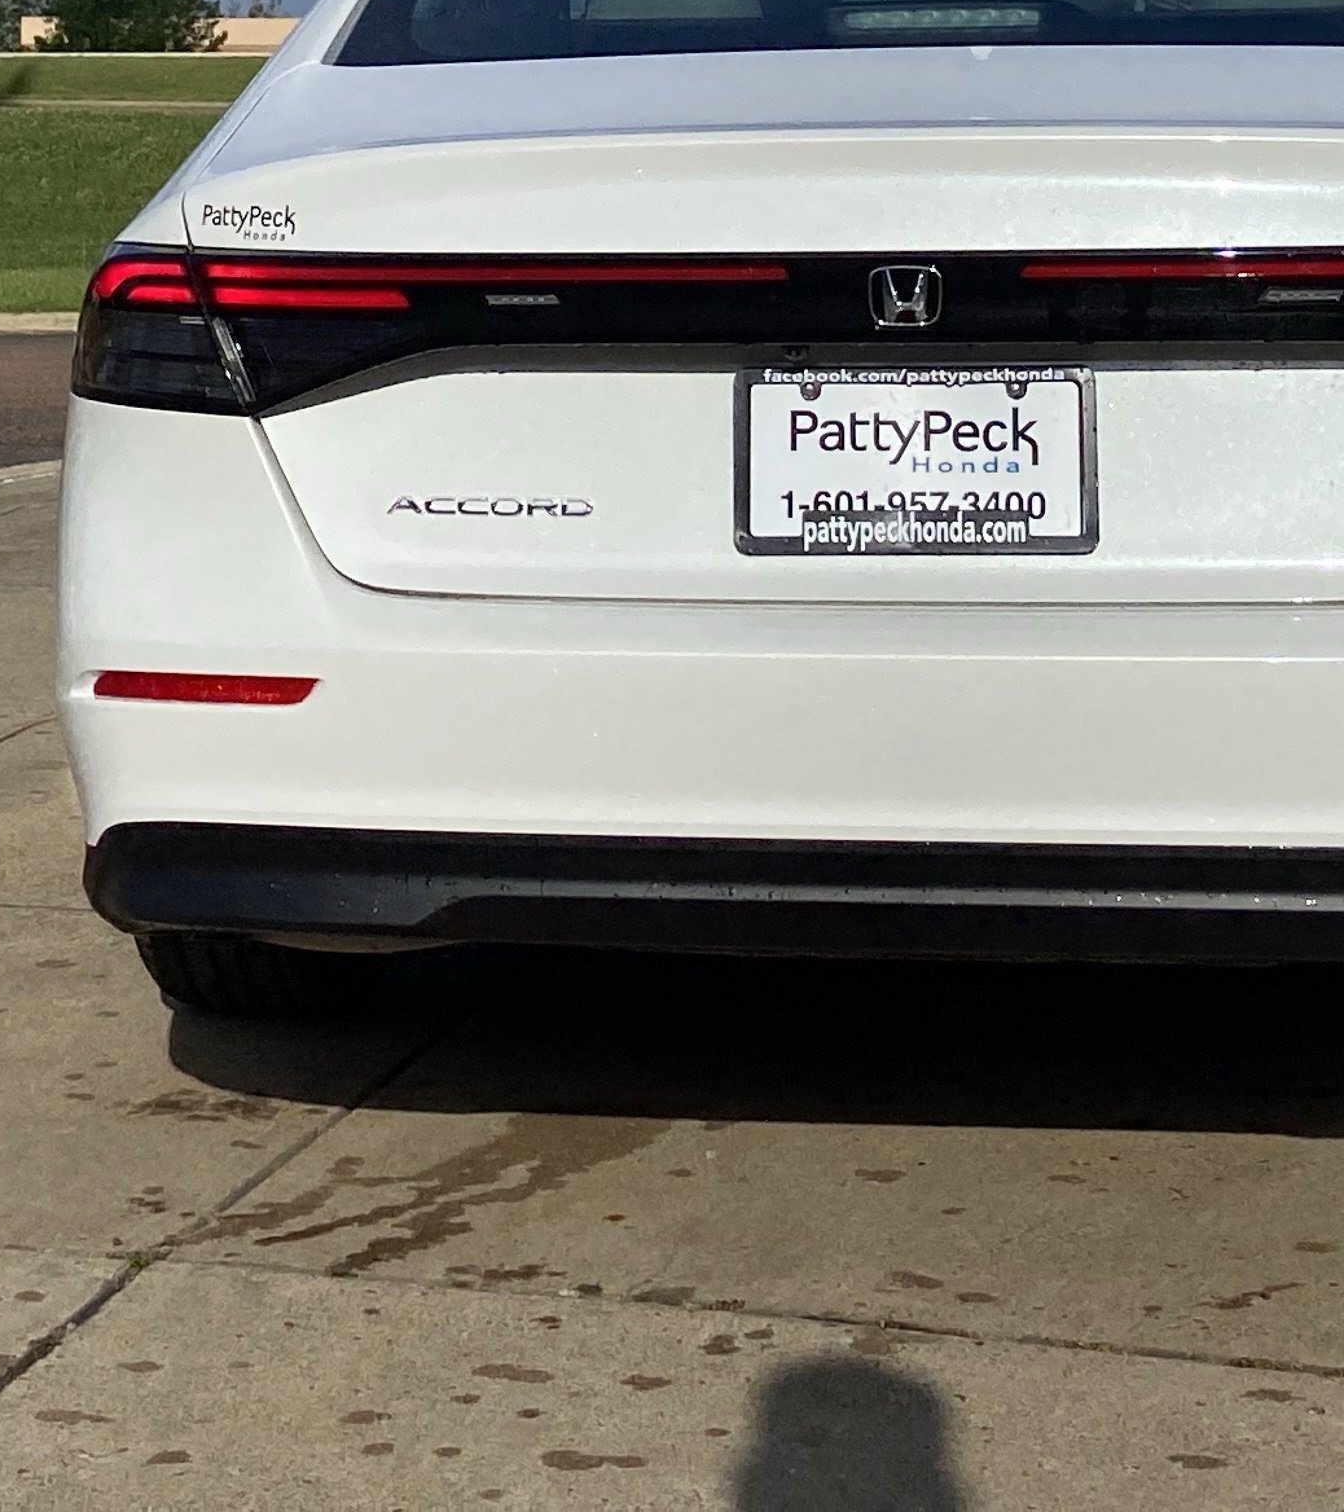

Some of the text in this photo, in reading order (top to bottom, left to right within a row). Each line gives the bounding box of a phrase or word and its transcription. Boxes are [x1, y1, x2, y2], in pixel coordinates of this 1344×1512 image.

[202, 204, 296, 235] PattyPeck
[762, 368, 1065, 386] facebook.com/pattypeckhonda
[789, 407, 1039, 466] PattyPeck
[911, 457, 1021, 474] Honda
[387, 496, 594, 516] ACCORD
[803, 511, 1027, 552] pattypeckhonda.com
